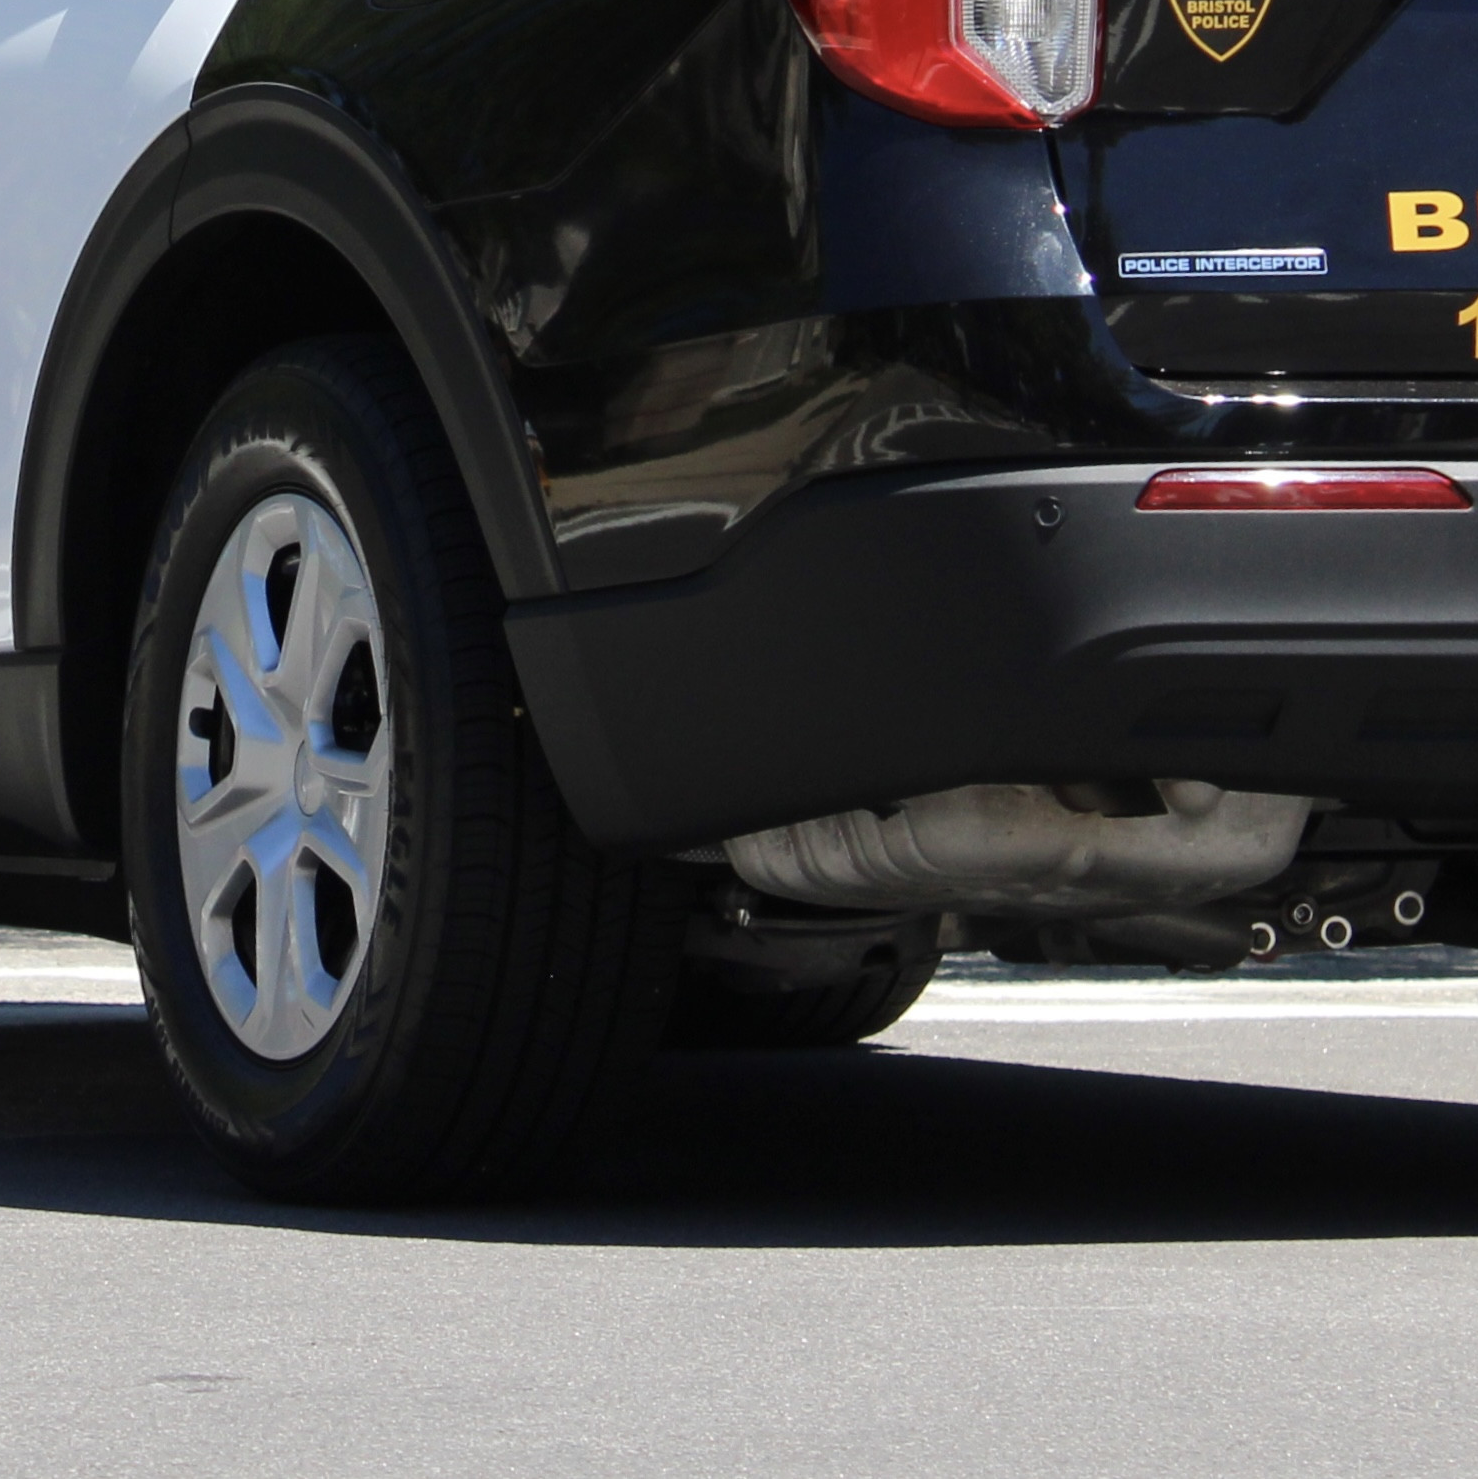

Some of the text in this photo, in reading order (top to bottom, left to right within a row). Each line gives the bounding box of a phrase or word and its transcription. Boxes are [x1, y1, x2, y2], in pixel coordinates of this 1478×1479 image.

[1187, 0, 1256, 14] BRISTOL
[1192, 15, 1250, 29] POLICE
[1124, 254, 1322, 273] POLICE INTERCEPTOR
